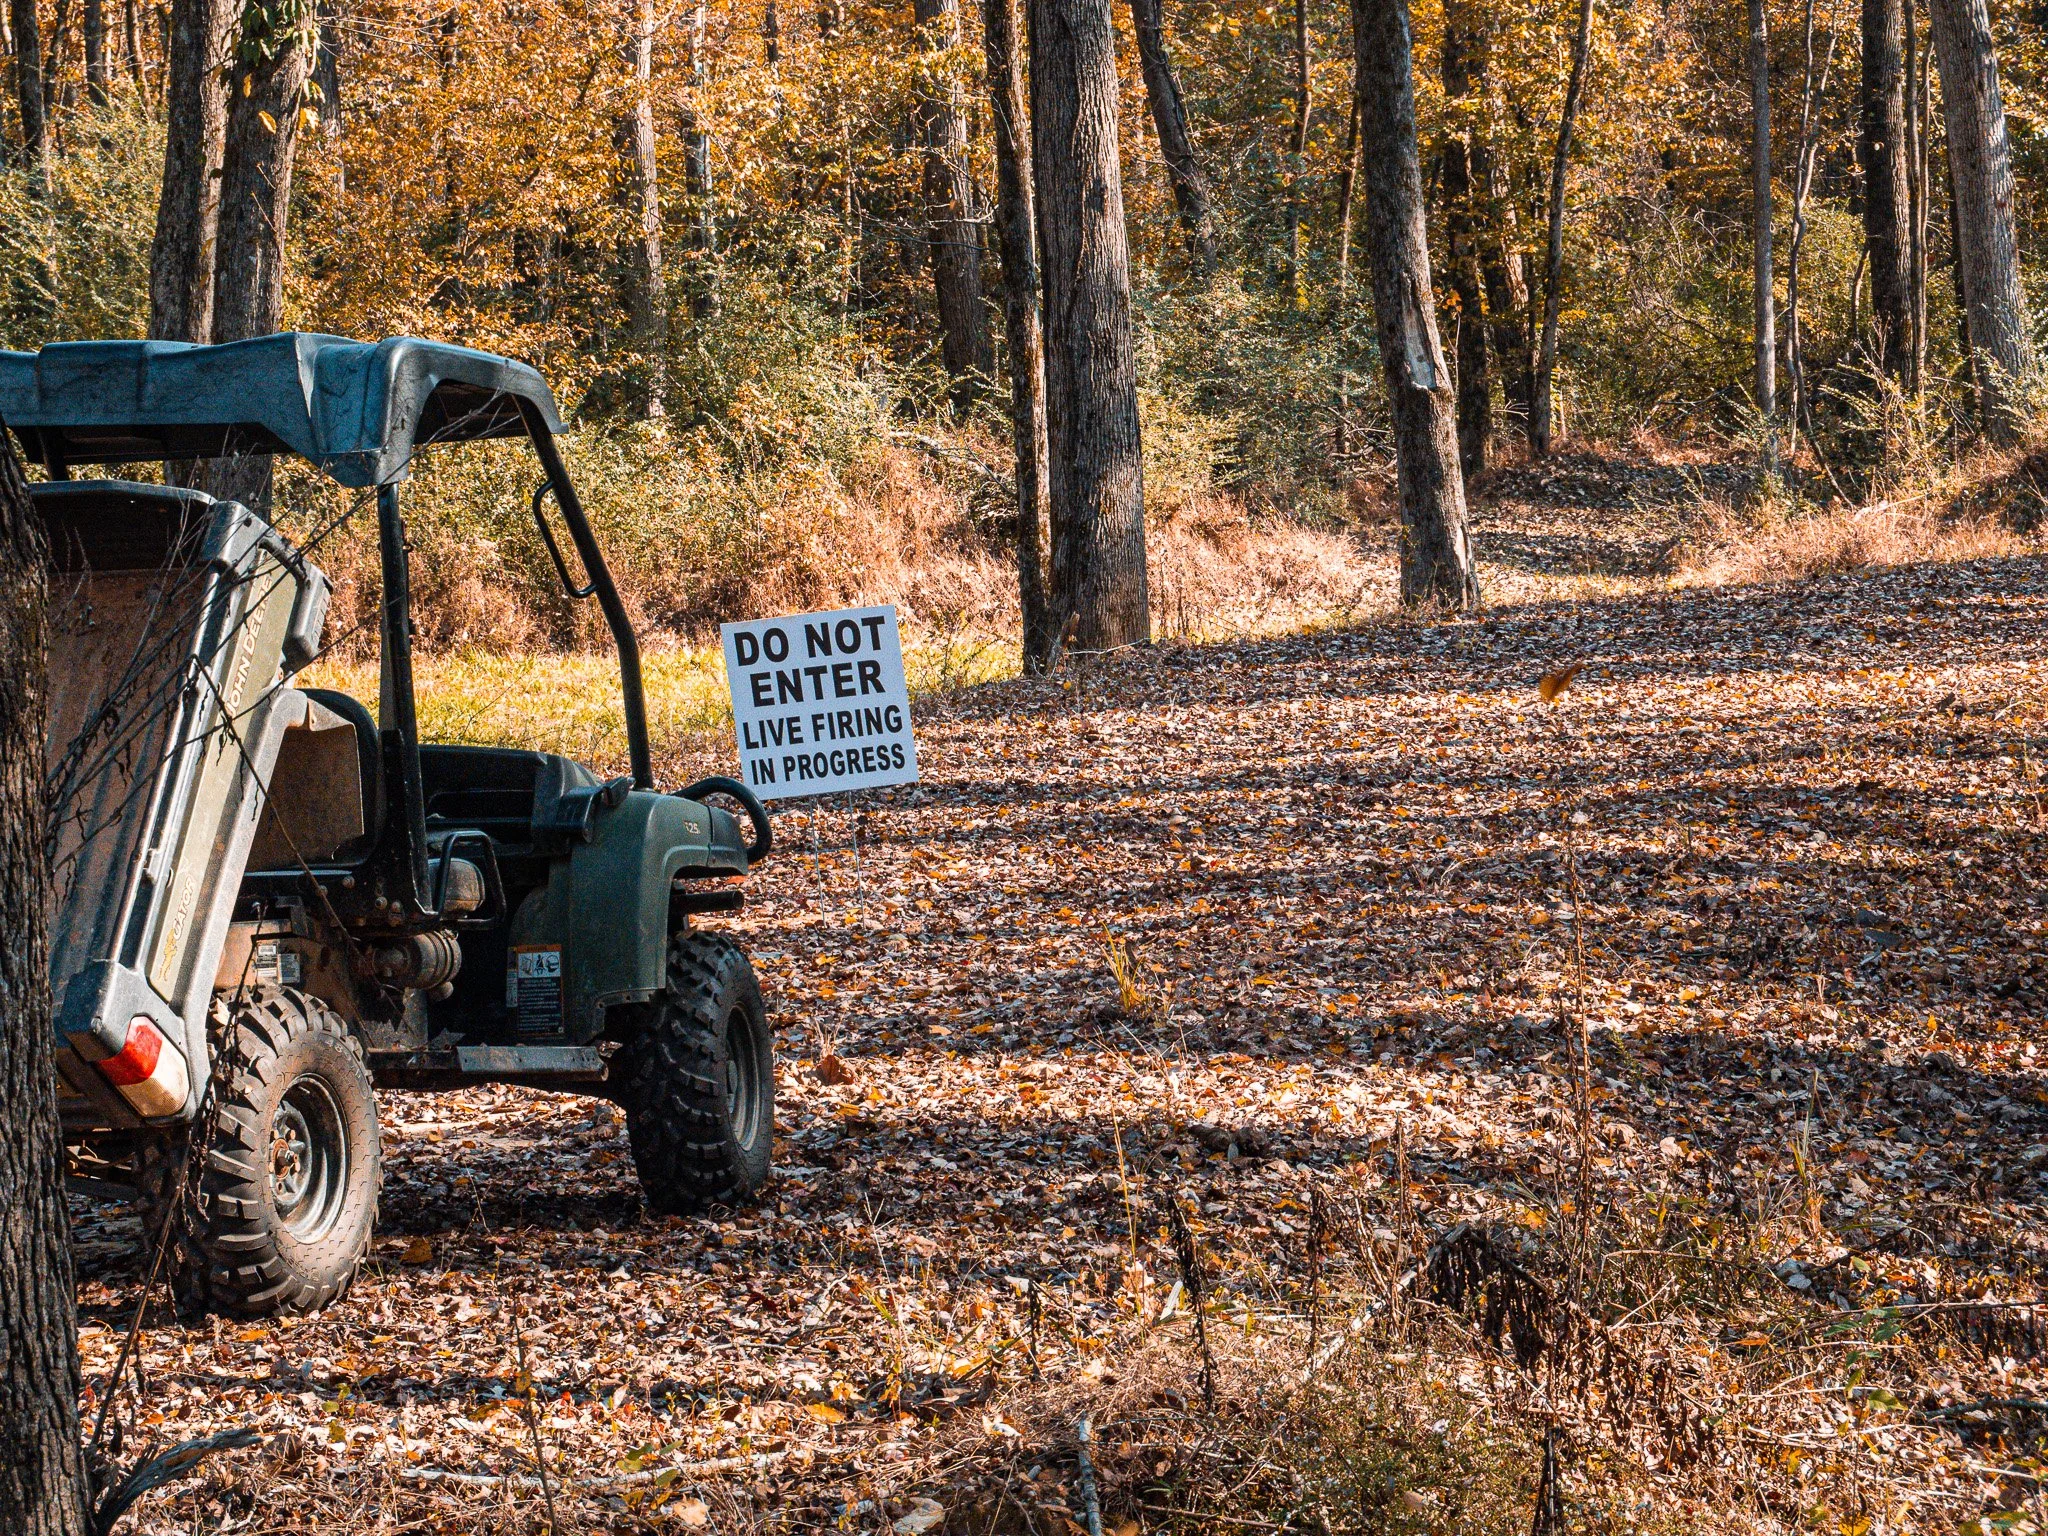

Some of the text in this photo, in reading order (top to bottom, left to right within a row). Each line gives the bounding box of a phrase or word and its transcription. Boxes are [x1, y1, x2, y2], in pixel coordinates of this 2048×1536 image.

[734, 616, 885, 666] DO NOT
[224, 656, 251, 717] JOHN
[750, 660, 886, 707] ENTER
[742, 705, 903, 750] LIVE FIRING
[750, 743, 906, 785] IN PROGRESS
